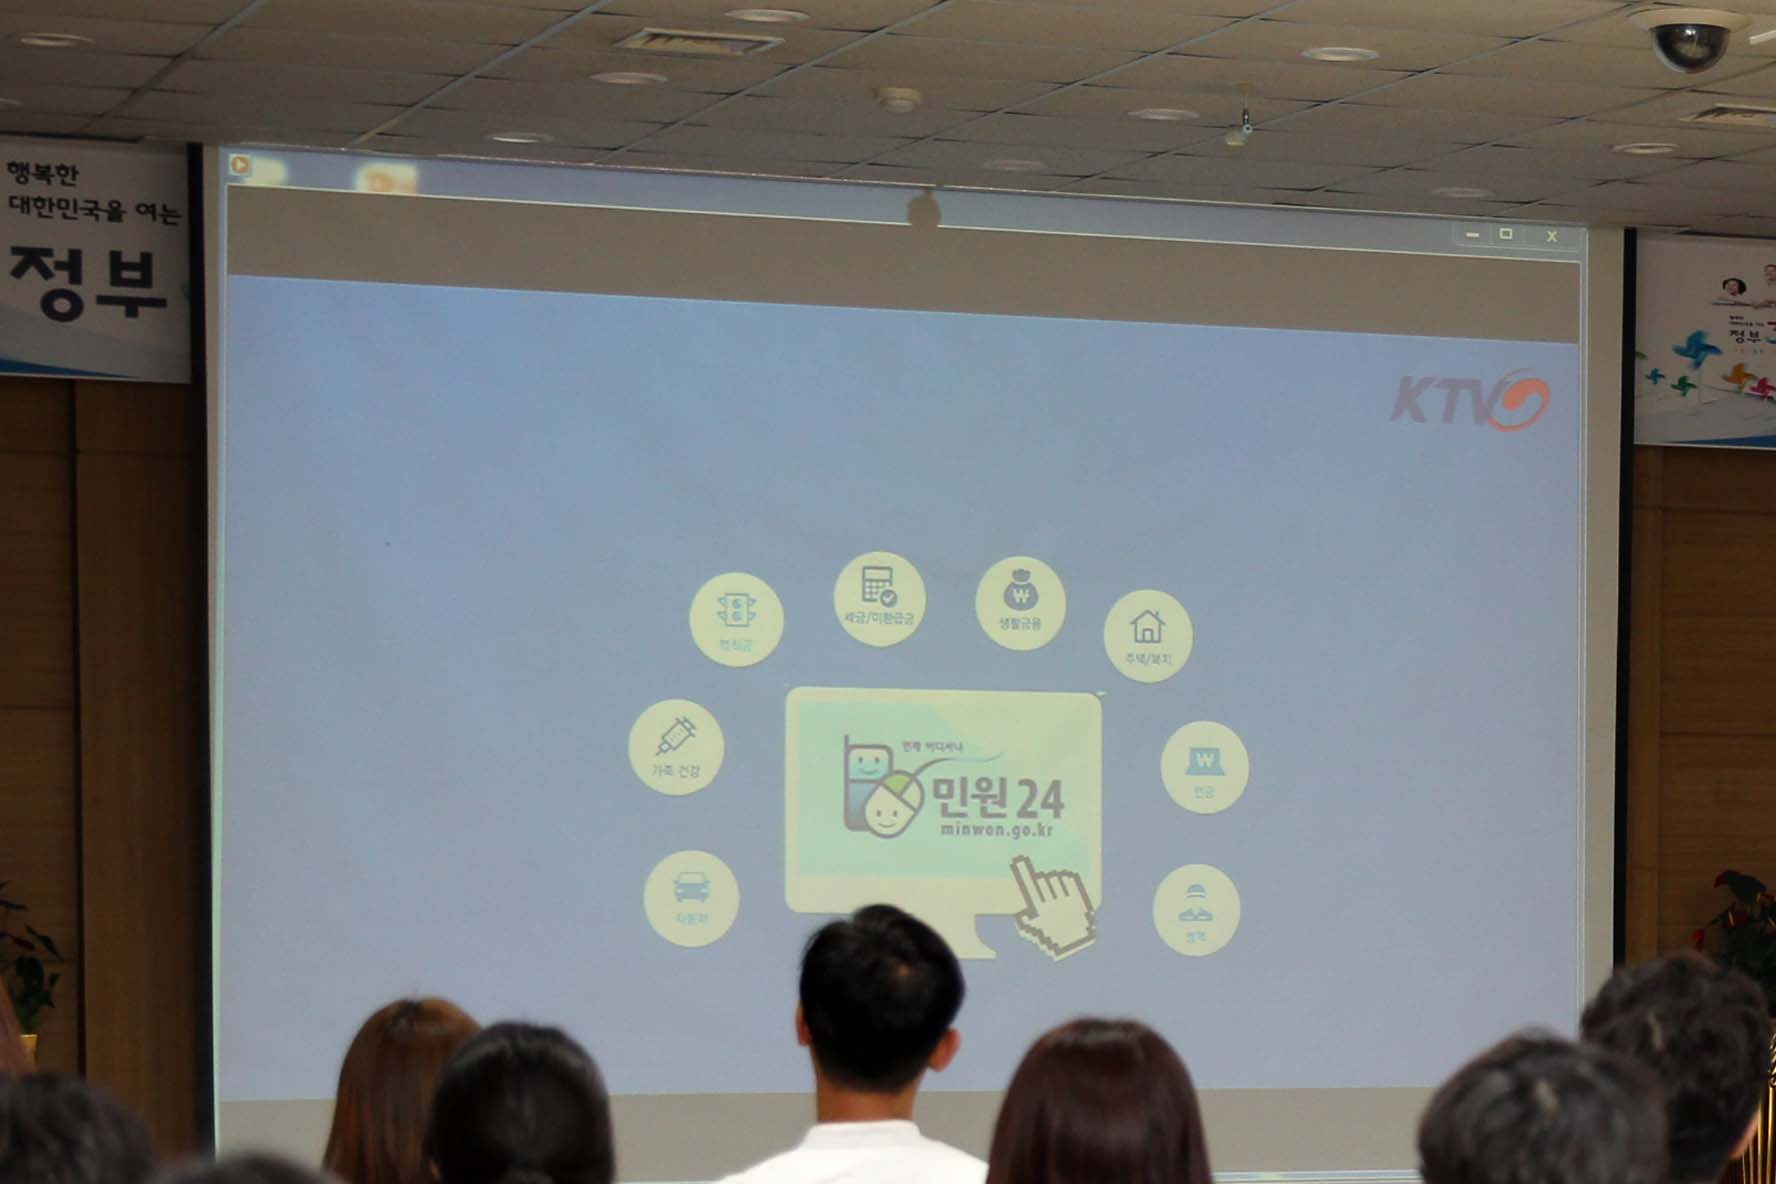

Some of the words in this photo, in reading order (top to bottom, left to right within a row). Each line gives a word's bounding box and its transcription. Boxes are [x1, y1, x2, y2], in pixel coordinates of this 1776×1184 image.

[7, 160, 79, 187] 행복한
[8, 195, 126, 223] 대한민국을
[136, 202, 182, 226] 여는
[10, 246, 167, 322] 정부
[1729, 329, 1761, 344] 정부
[1389, 375, 1512, 425] KTV
[1000, 617, 1041, 631] 생활금융
[652, 763, 673, 777] 가족
[679, 763, 701, 778] 건강
[941, 821, 1054, 840] minwon.go.kr
